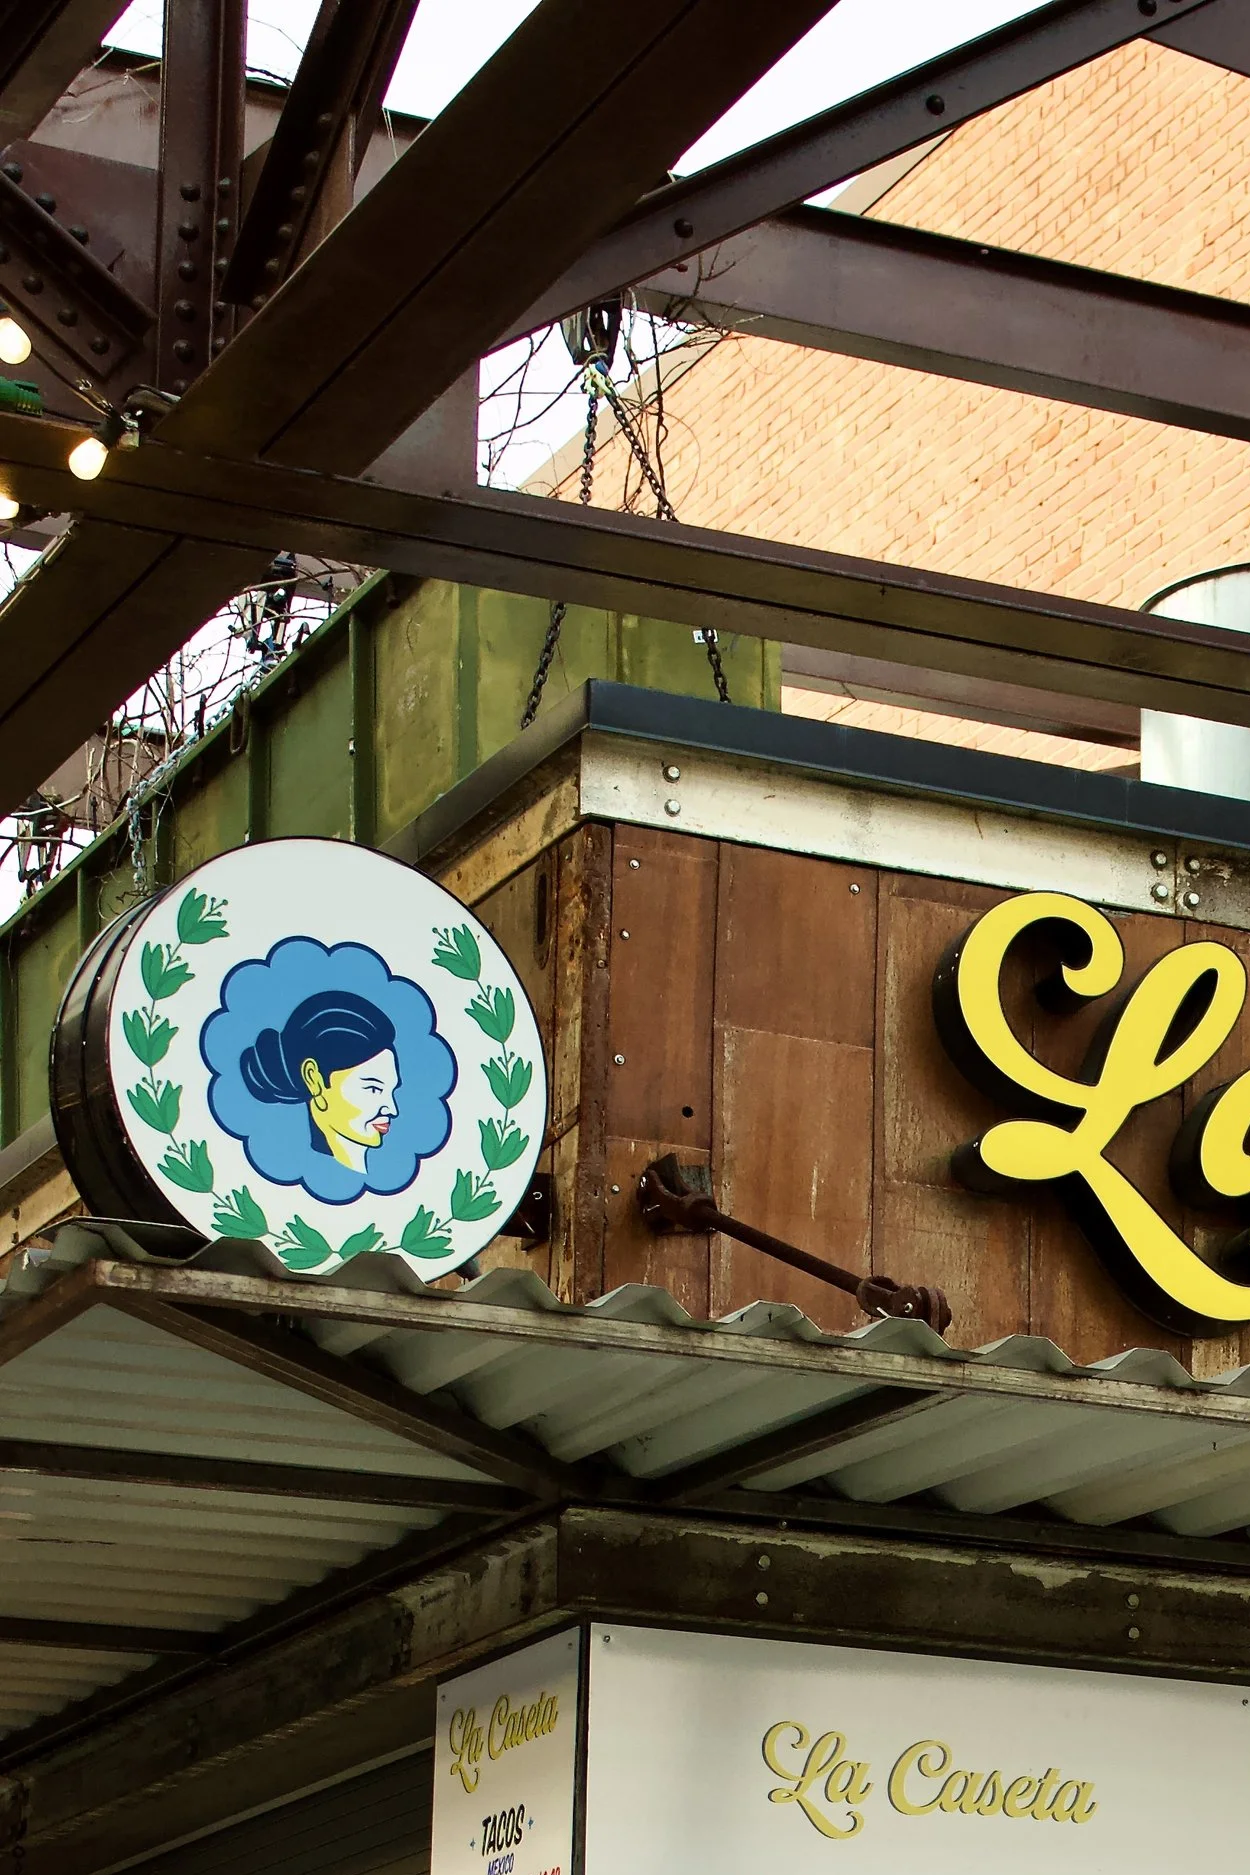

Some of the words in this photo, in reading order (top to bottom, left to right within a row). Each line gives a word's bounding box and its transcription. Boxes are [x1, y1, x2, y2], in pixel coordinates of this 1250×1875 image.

[449, 1706, 485, 1794] La
[487, 1690, 559, 1761] Caseta
[761, 1720, 875, 1840] La
[887, 1739, 1100, 1825] Caseta
[481, 1803, 526, 1857] TACOS
